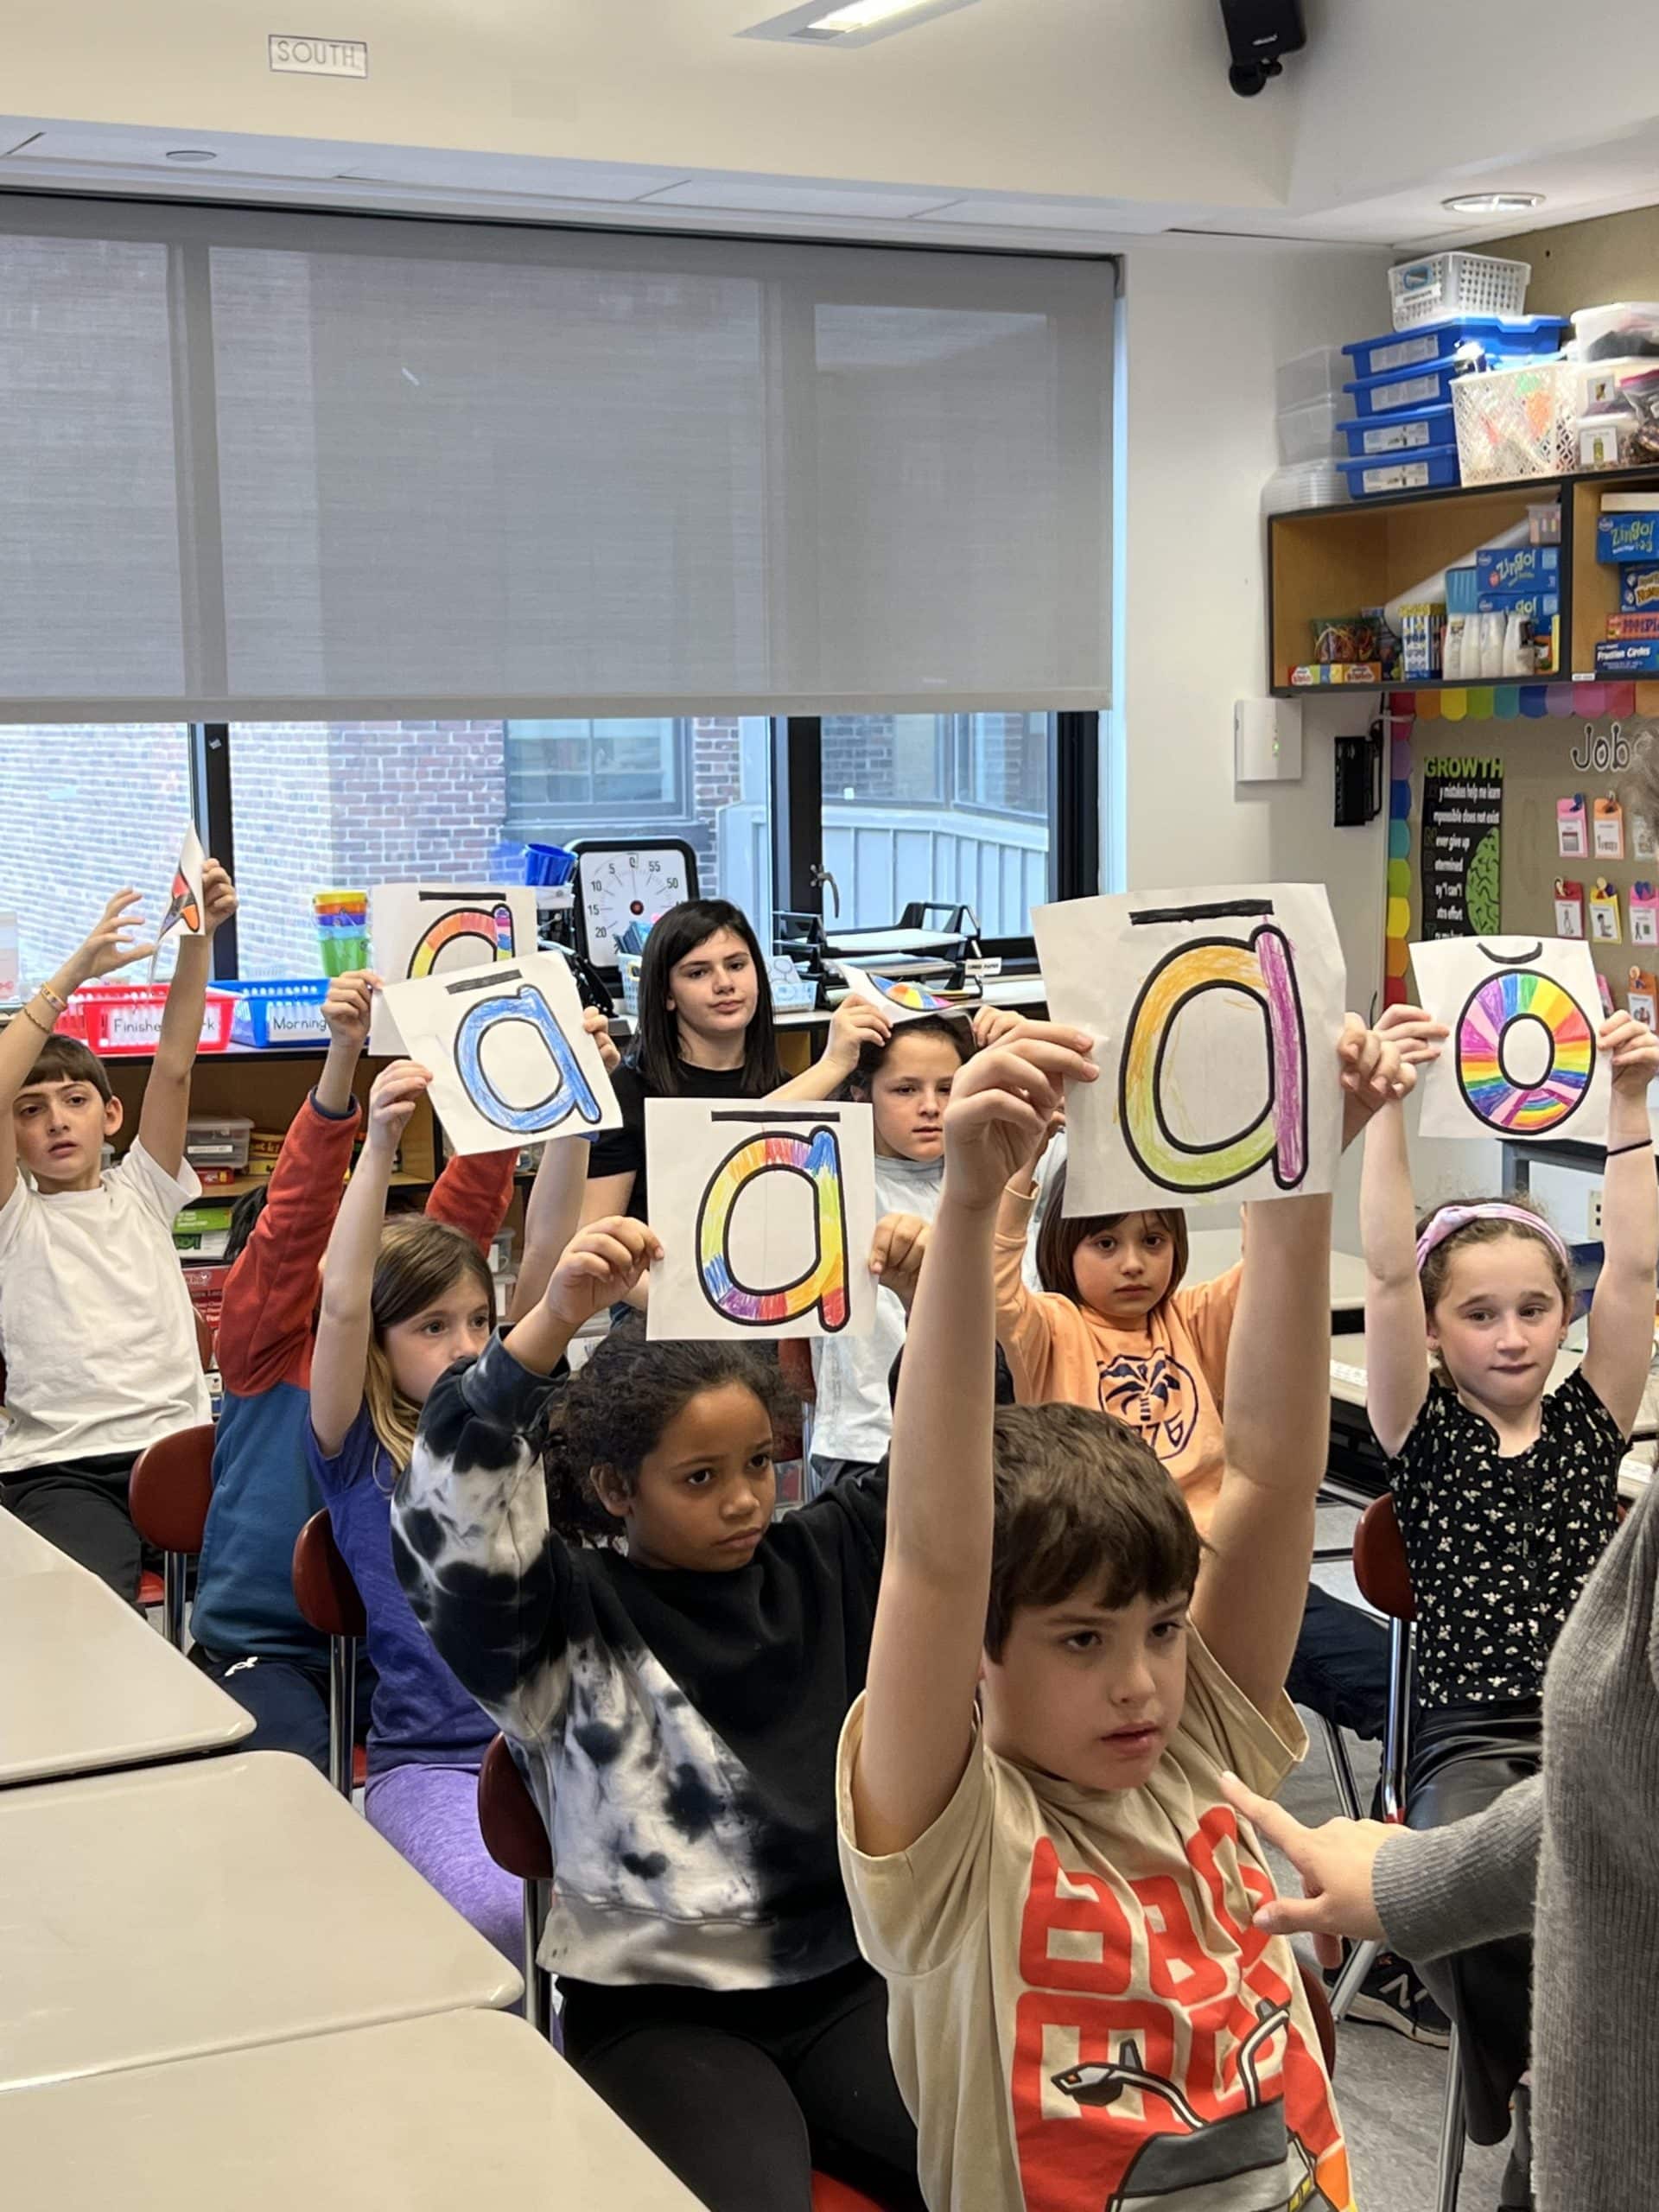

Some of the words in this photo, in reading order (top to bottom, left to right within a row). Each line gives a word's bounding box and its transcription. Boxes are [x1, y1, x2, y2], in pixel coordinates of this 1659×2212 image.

[276, 40, 355, 67] SOUTH
[1570, 722, 1631, 772] Job
[1424, 757, 1503, 778] GROWTH
[608, 863, 616, 874] 5
[629, 857, 636, 868] 0
[649, 861, 661, 873] 55
[591, 880, 602, 892] 10
[666, 877, 678, 889] 50
[588, 905, 600, 916] 15
[595, 926, 607, 938] 20
[114, 1018, 162, 1033] Finishe
[273, 1016, 327, 1033] Morning
